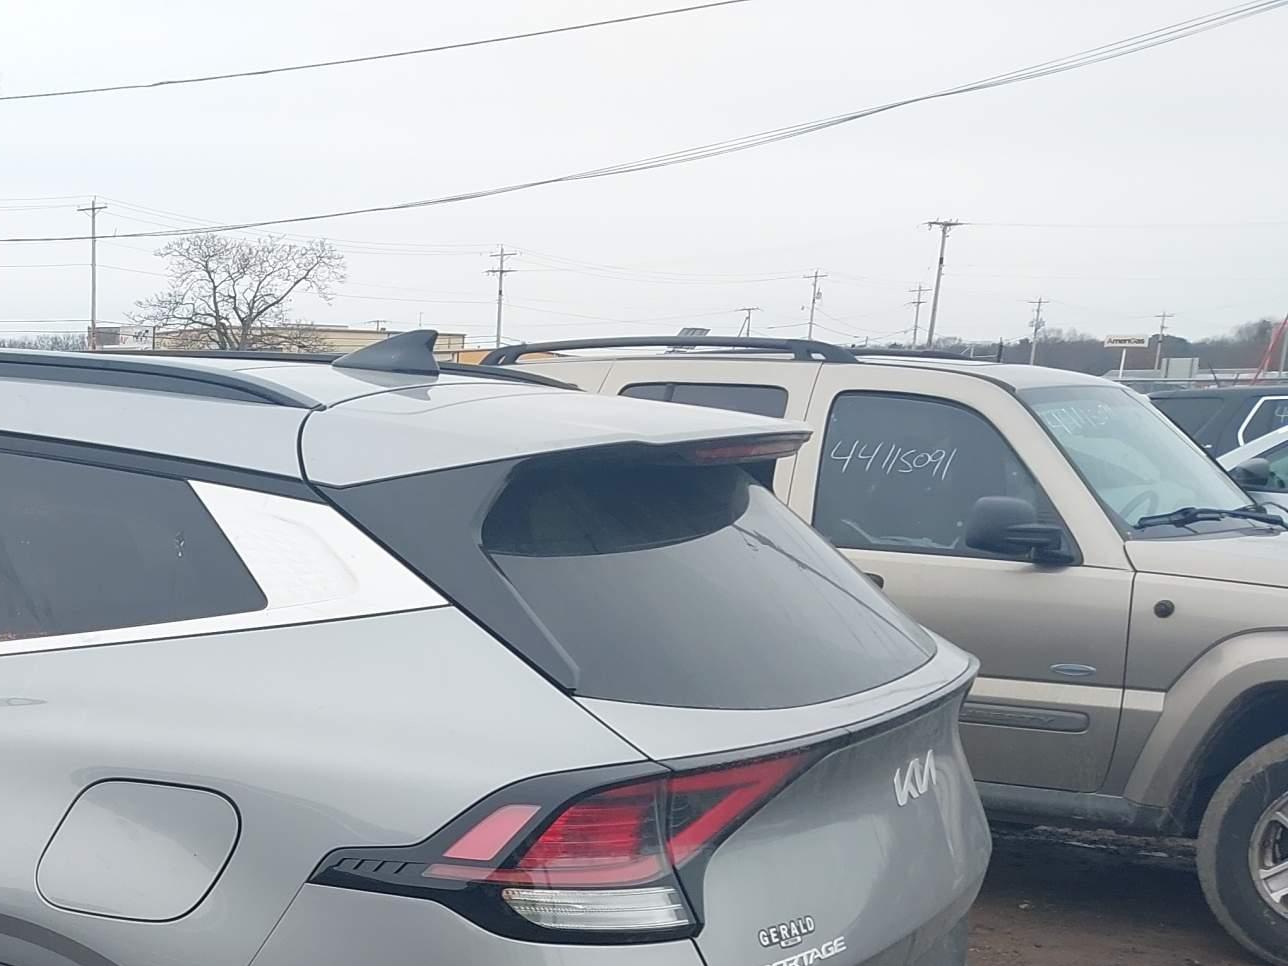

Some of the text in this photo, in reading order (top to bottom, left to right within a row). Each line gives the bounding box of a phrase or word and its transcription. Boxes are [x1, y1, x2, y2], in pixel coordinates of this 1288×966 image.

[831, 440, 957, 480] 44115091
[894, 749, 936, 806] KIA
[758, 916, 815, 946] GERALD
